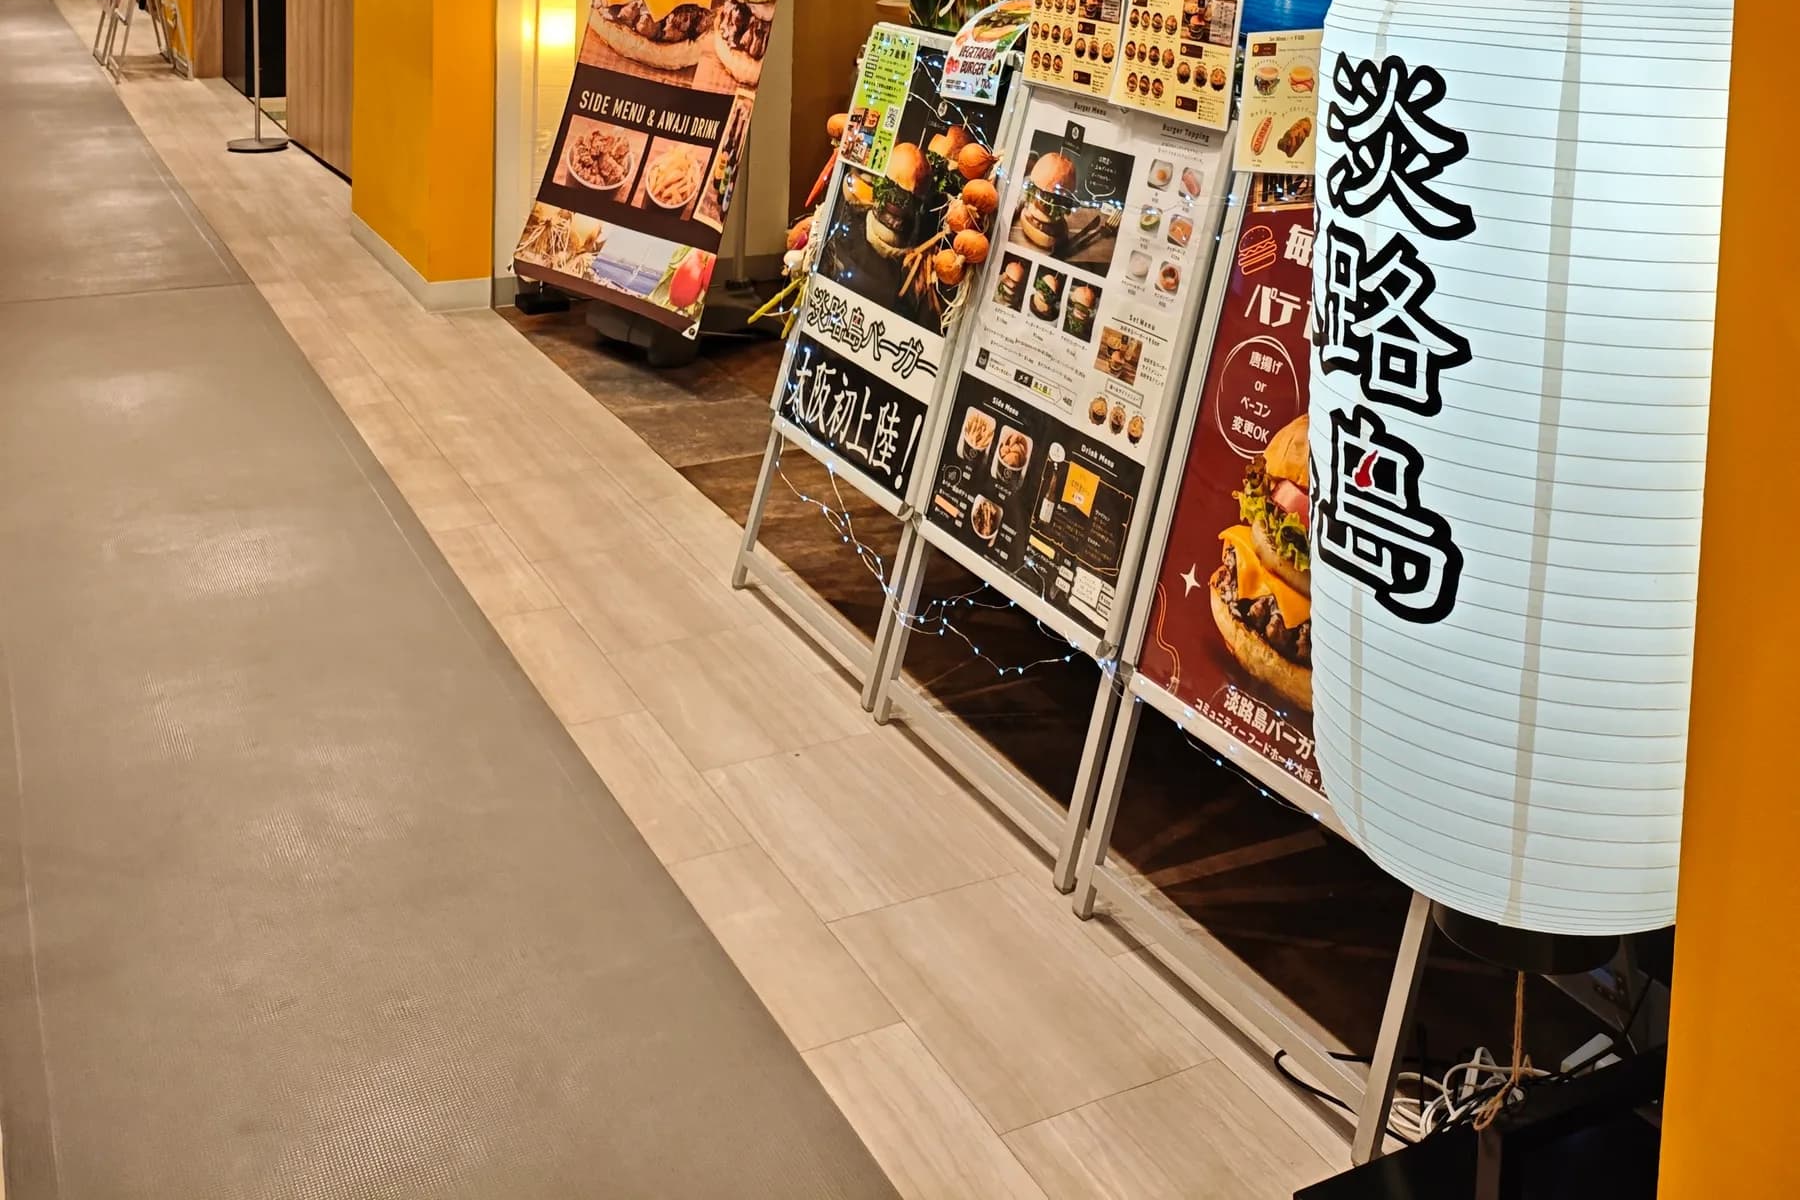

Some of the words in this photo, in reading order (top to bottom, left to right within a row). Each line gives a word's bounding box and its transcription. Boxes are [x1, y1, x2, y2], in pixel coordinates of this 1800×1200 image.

[960, 60, 987, 75] BURGER
[579, 90, 611, 115] SIDE
[612, 98, 647, 124] MENU
[647, 109, 656, 127] &
[657, 110, 691, 135] AWAJI
[690, 117, 721, 141] DRINK
[1074, 101, 1092, 113] Burger
[1092, 106, 1107, 117] Menu
[1162, 123, 1184, 136] Burger
[806, 287, 939, 380] 淡路島バーガー
[1314, 50, 1477, 625] 淡路島
[1249, 351, 1284, 375] 唐揚げ
[1254, 380, 1268, 393] or
[992, 396, 1005, 409] Side
[1004, 403, 1020, 417] Menu
[1241, 396, 1272, 418] ベーコン
[1232, 415, 1270, 444] 変更OK
[1081, 444, 1098, 460] Drink
[1098, 454, 1115, 469] Menu
